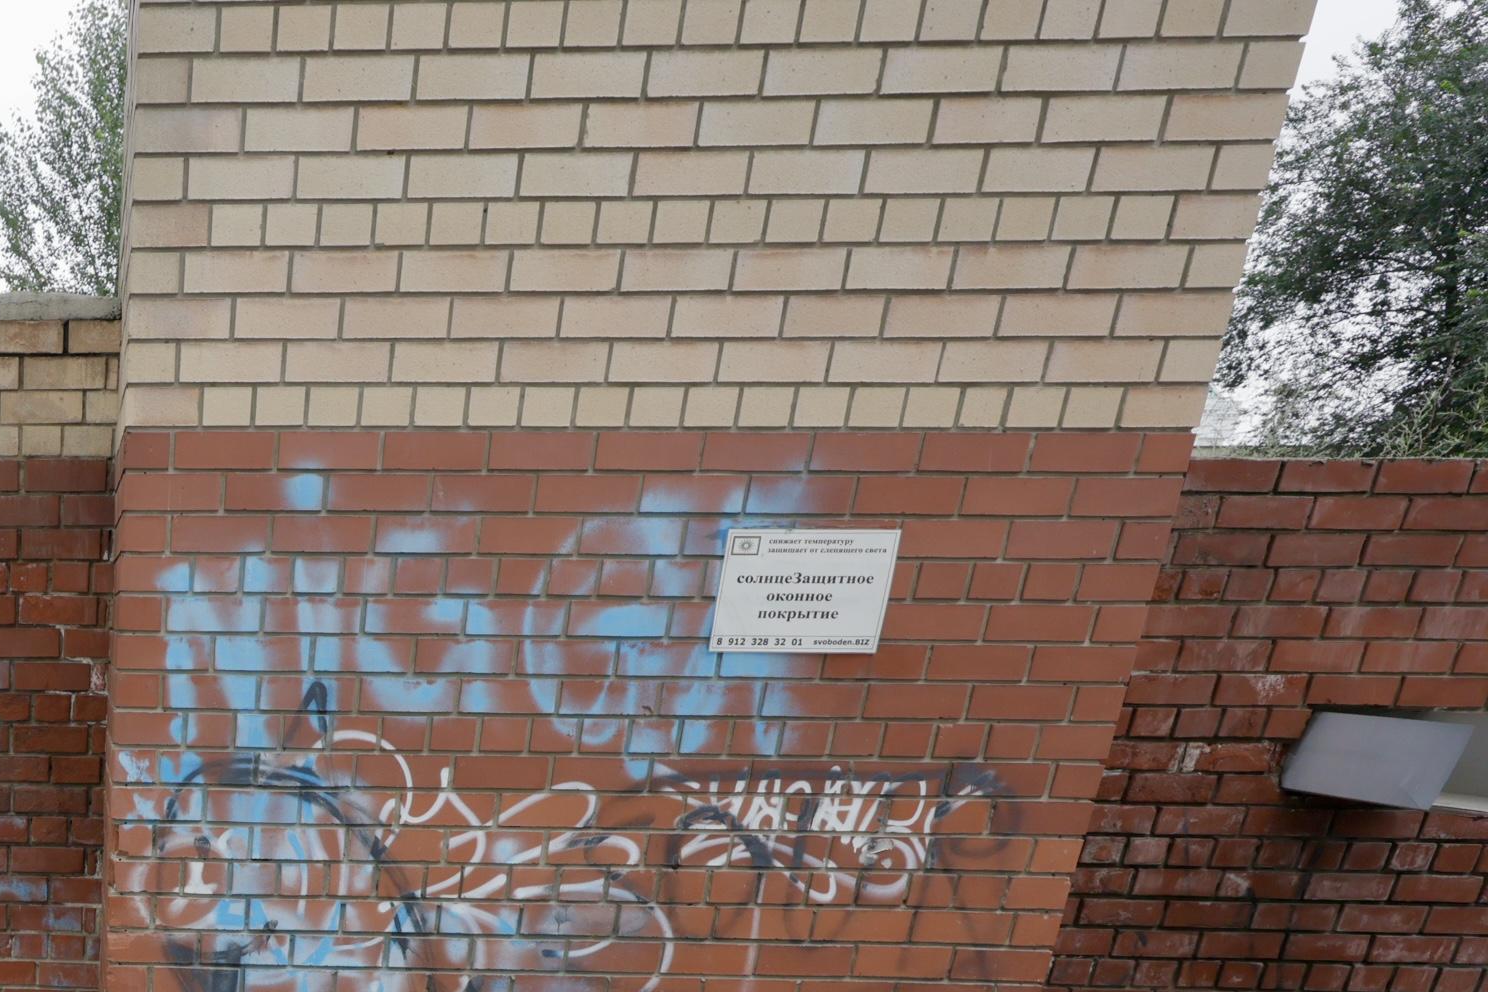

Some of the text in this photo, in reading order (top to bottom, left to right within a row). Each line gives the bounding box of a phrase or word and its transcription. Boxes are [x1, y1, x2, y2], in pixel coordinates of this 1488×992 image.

[736, 572, 875, 585] солнцеЗащитное
[766, 592, 833, 602] оконное
[758, 609, 839, 622] покрытие
[716, 638, 723, 646] 8
[728, 638, 746, 646] 912
[751, 638, 769, 646] 328
[791, 638, 803, 646] 01
